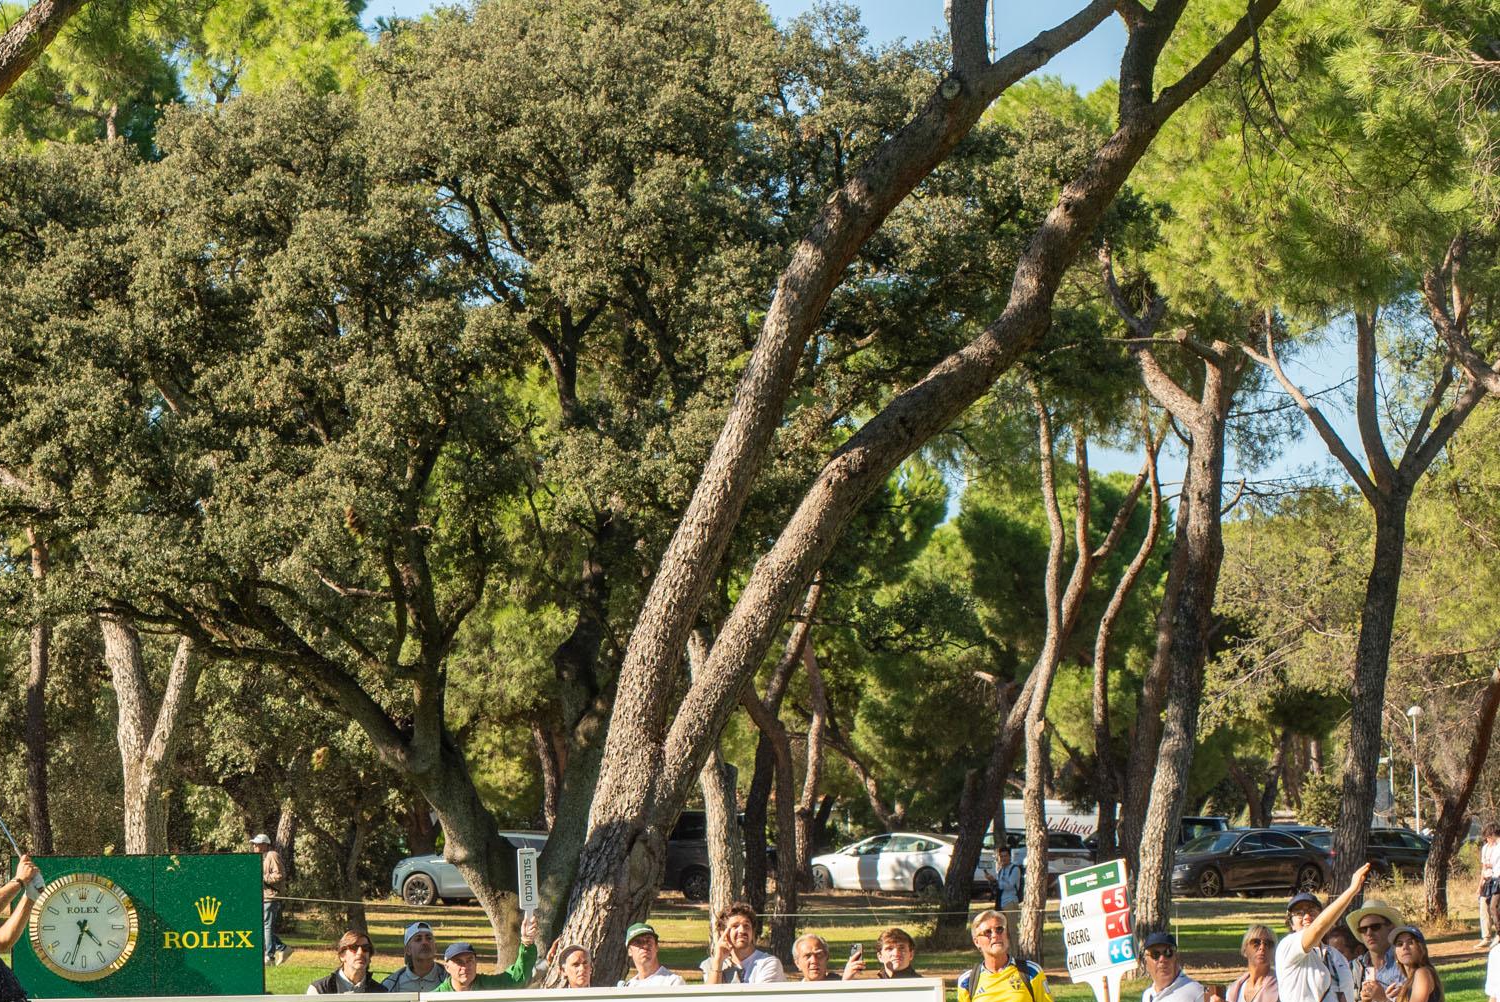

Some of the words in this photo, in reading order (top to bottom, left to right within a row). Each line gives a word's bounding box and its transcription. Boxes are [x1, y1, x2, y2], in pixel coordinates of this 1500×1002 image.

[523, 858, 533, 902] SILENCIO
[67, 906, 99, 914] ROLEX
[1061, 902, 1085, 920] AYORA
[163, 930, 255, 949] ROLEX
[1067, 928, 1091, 947] ABERG
[1068, 951, 1097, 971] HATTON
